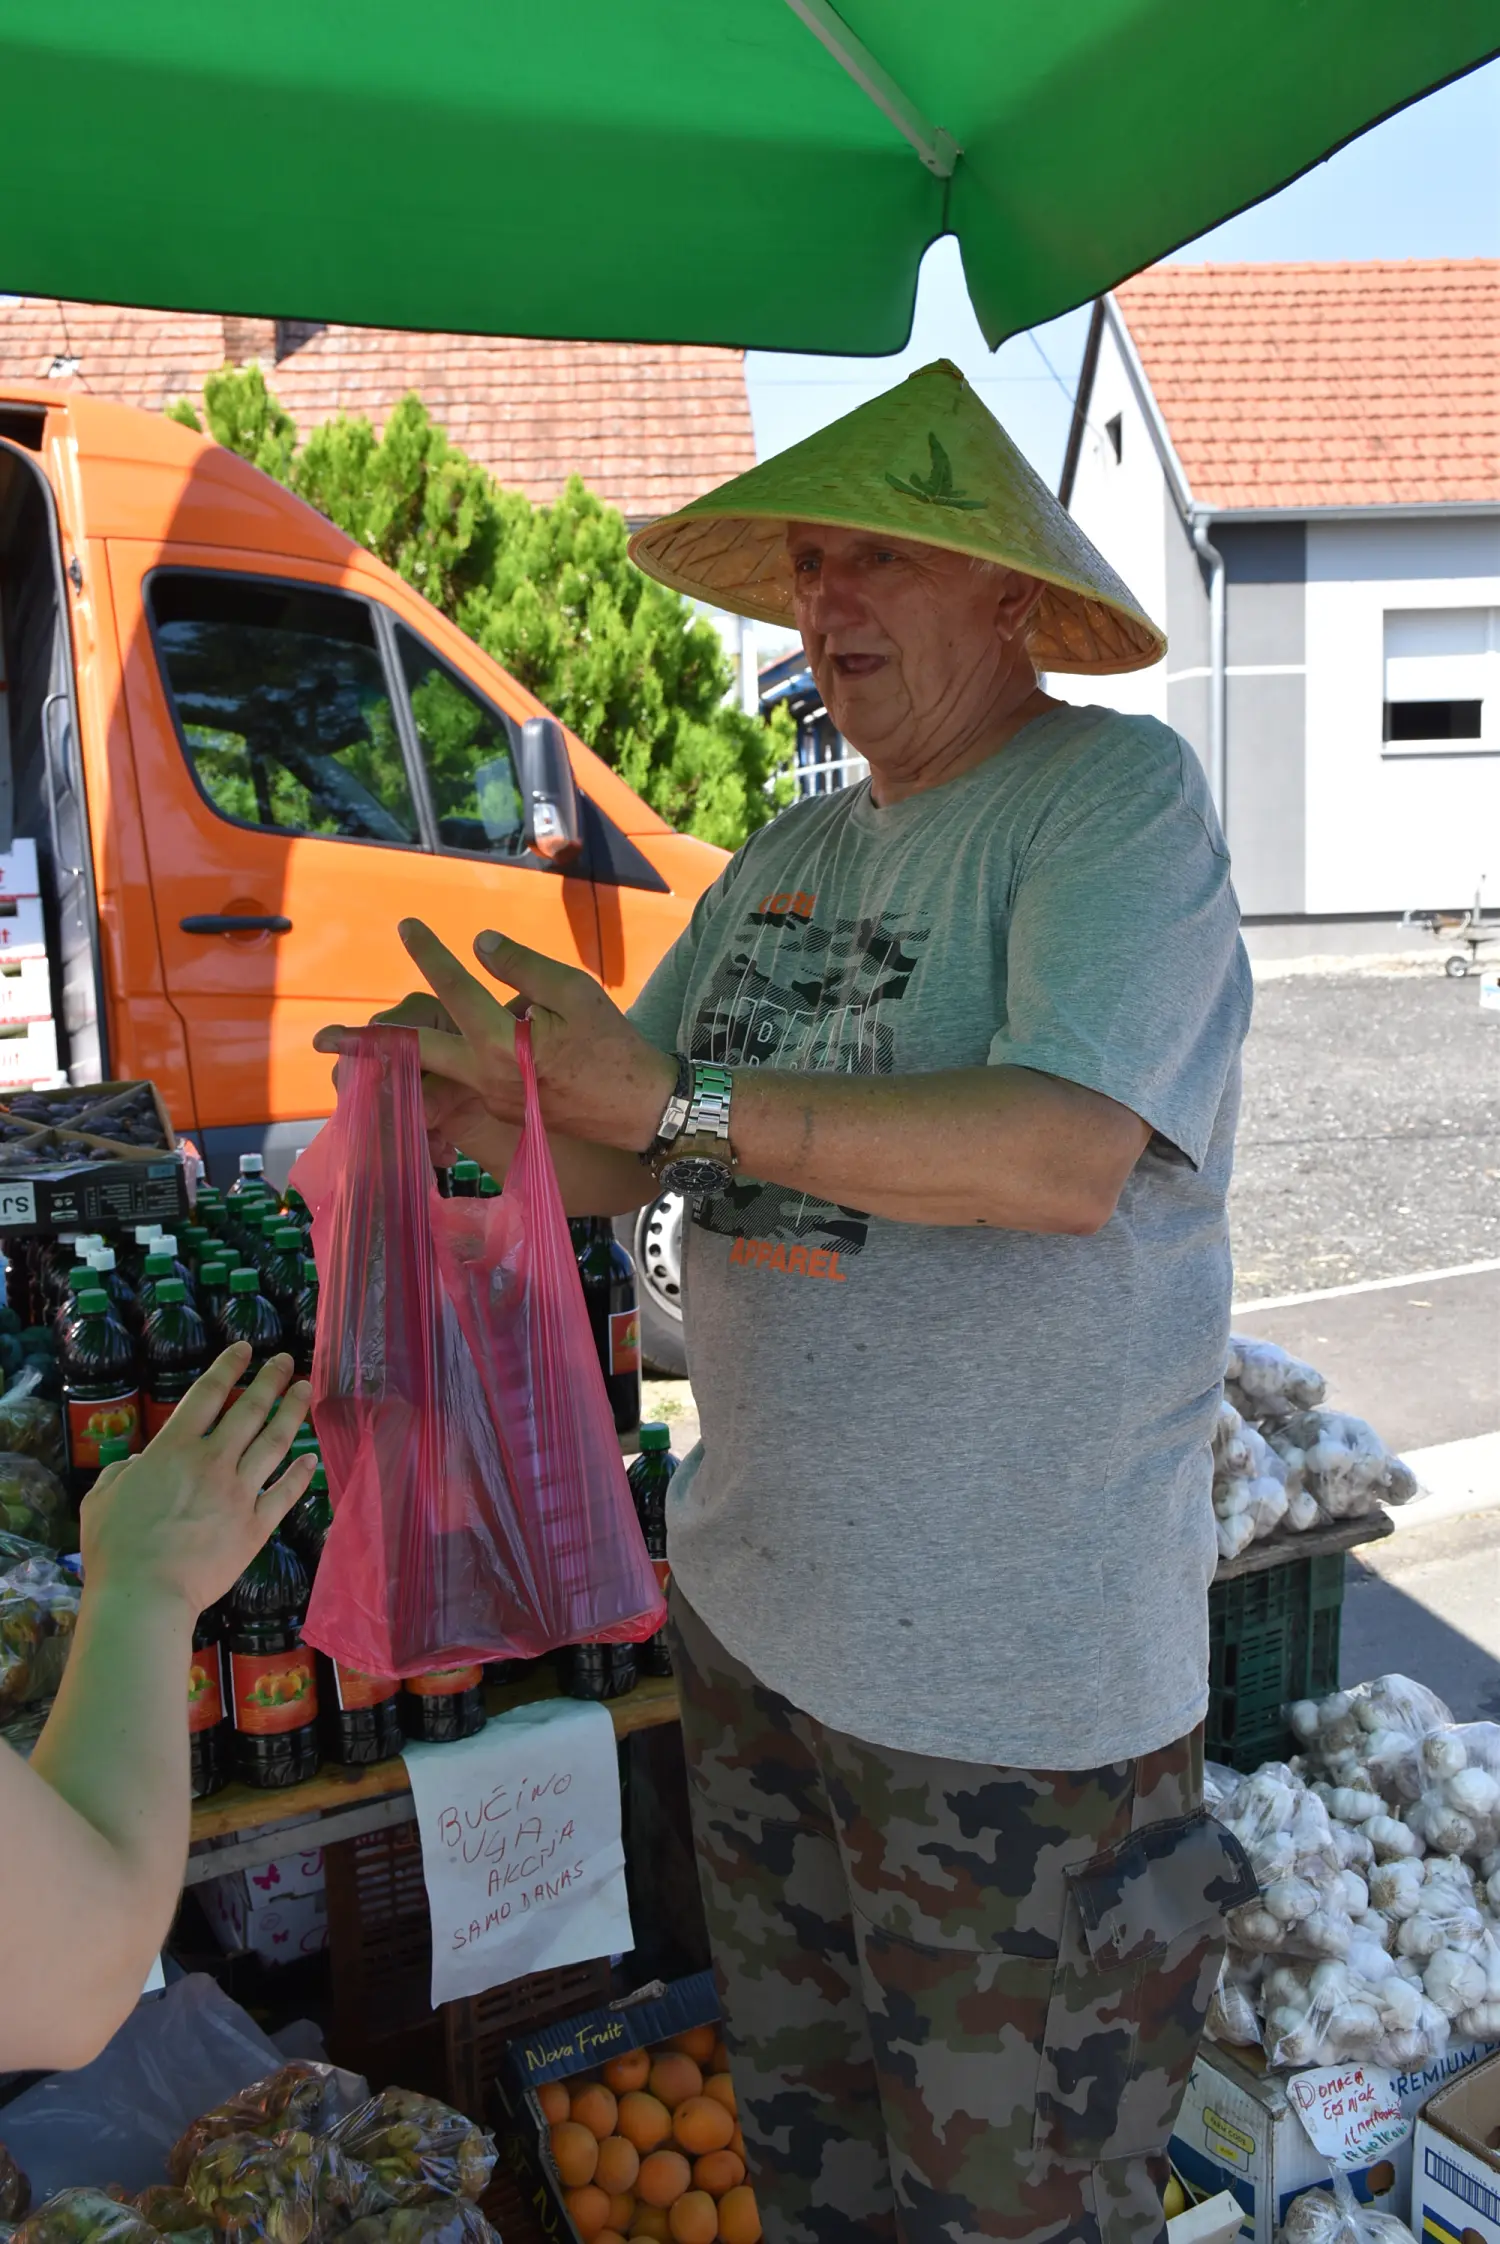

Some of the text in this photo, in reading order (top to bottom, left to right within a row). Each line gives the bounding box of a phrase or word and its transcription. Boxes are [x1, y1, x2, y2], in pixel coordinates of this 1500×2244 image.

[729, 1235, 847, 1282] APPAREL
[525, 2023, 625, 2071] Nova Fruit
